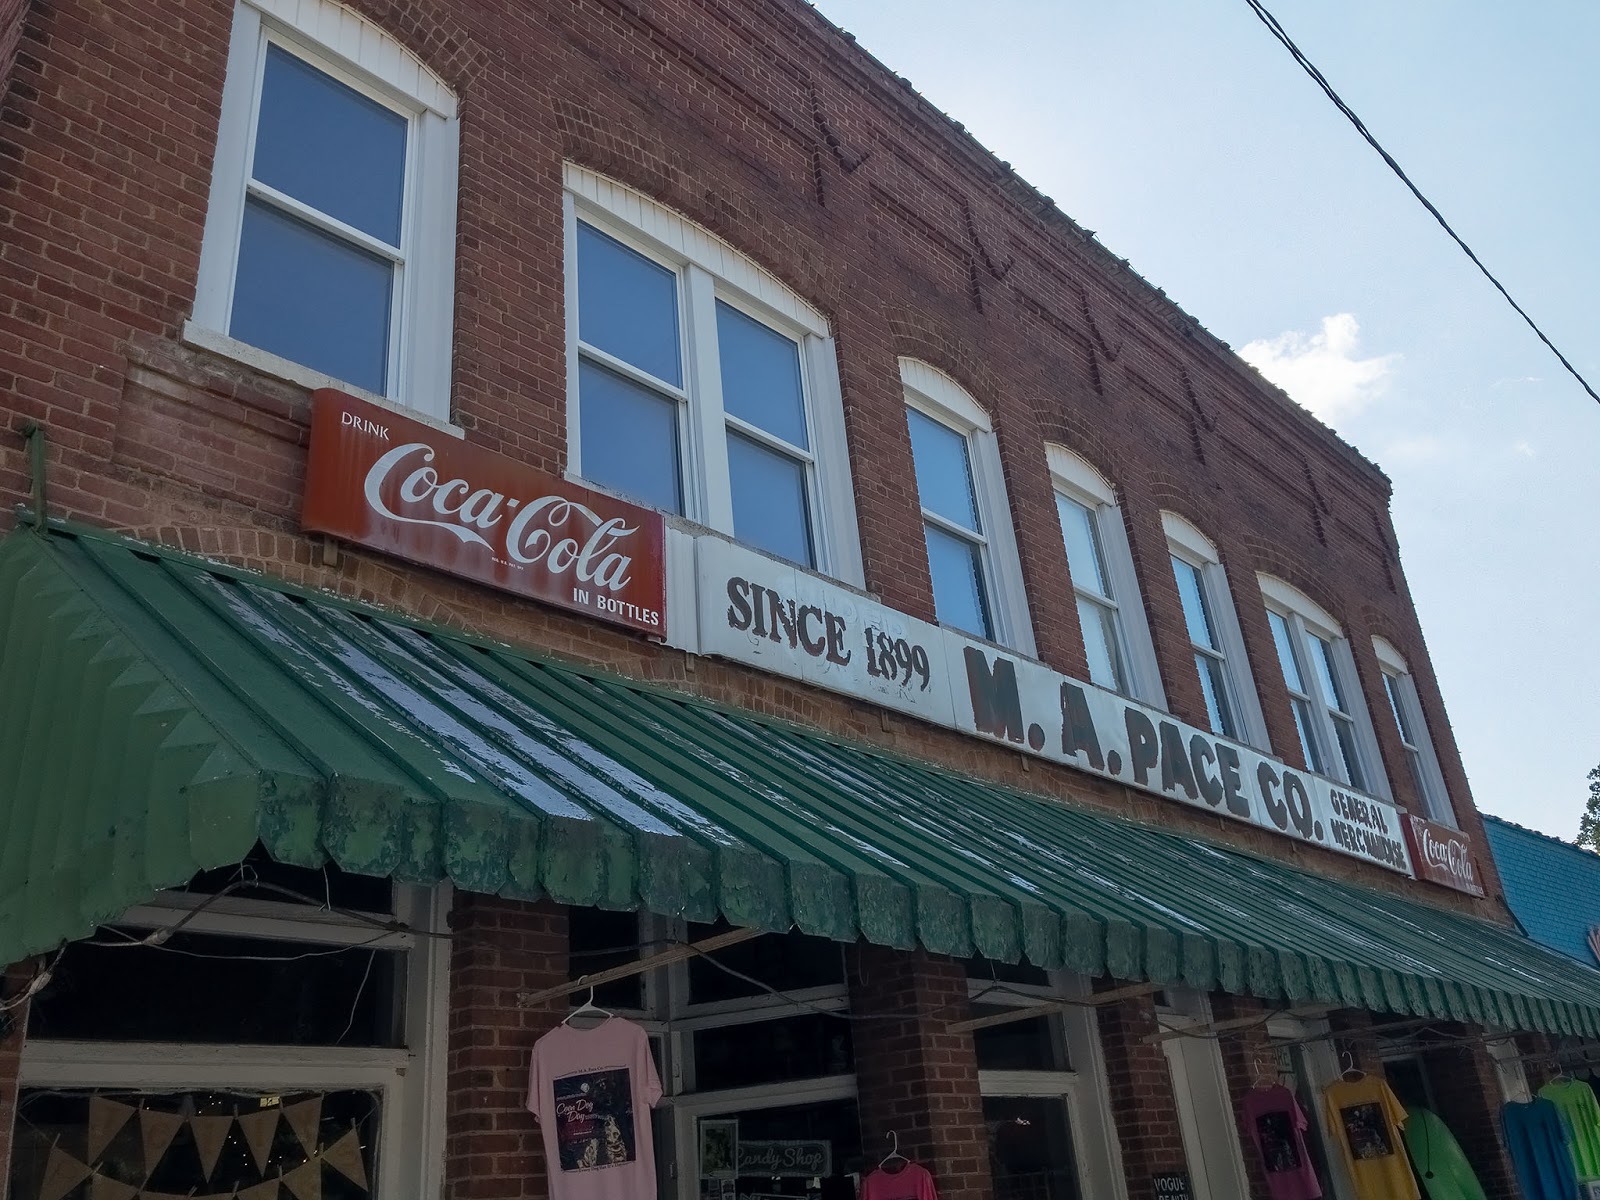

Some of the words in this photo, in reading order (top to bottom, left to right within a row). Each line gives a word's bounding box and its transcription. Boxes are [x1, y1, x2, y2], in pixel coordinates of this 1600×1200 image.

[341, 410, 390, 441] DRINK
[364, 442, 641, 592] Coca-Cola
[573, 587, 589, 605] IN
[597, 595, 660, 626] BOTTLES
[727, 576, 851, 667] SINCE
[864, 626, 931, 692] 1899
[963, 645, 1046, 751] M.
[1060, 680, 1123, 776] A.
[1124, 706, 1251, 818] PACE
[1256, 760, 1325, 842] CO.
[1330, 788, 1389, 835] GENERAL
[567, 1111, 585, 1124] Day
[576, 1099, 594, 1113] Dog
[782, 1147, 824, 1171] Shop
[1153, 1177, 1185, 1192] VOGUE
